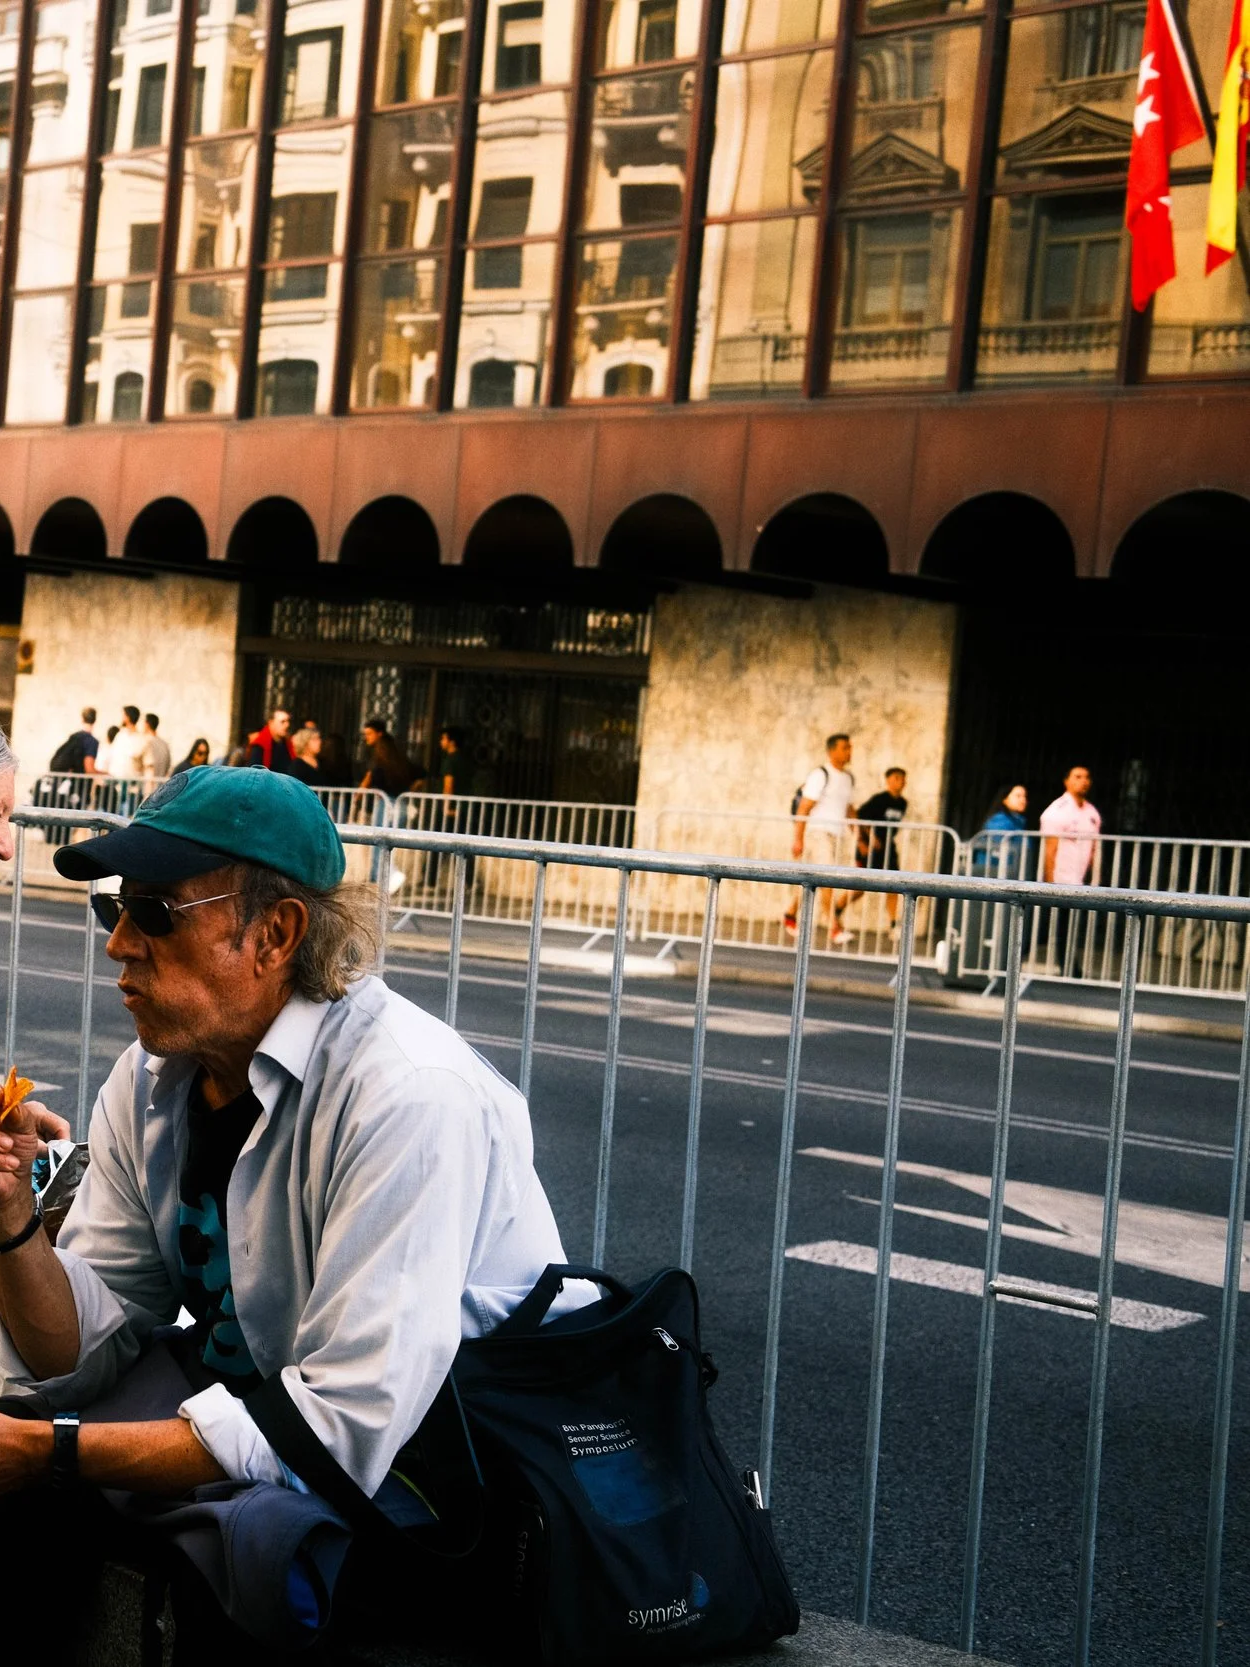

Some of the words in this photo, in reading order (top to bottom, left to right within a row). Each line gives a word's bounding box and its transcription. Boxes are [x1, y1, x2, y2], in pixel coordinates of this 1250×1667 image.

[561, 1424, 580, 1432] 8th
[579, 1418, 626, 1431] Pangborn
[567, 1435, 599, 1443] Sensory
[599, 1429, 631, 1440] Science
[570, 1437, 638, 1456] Symposium
[628, 1598, 688, 1629] symrise
